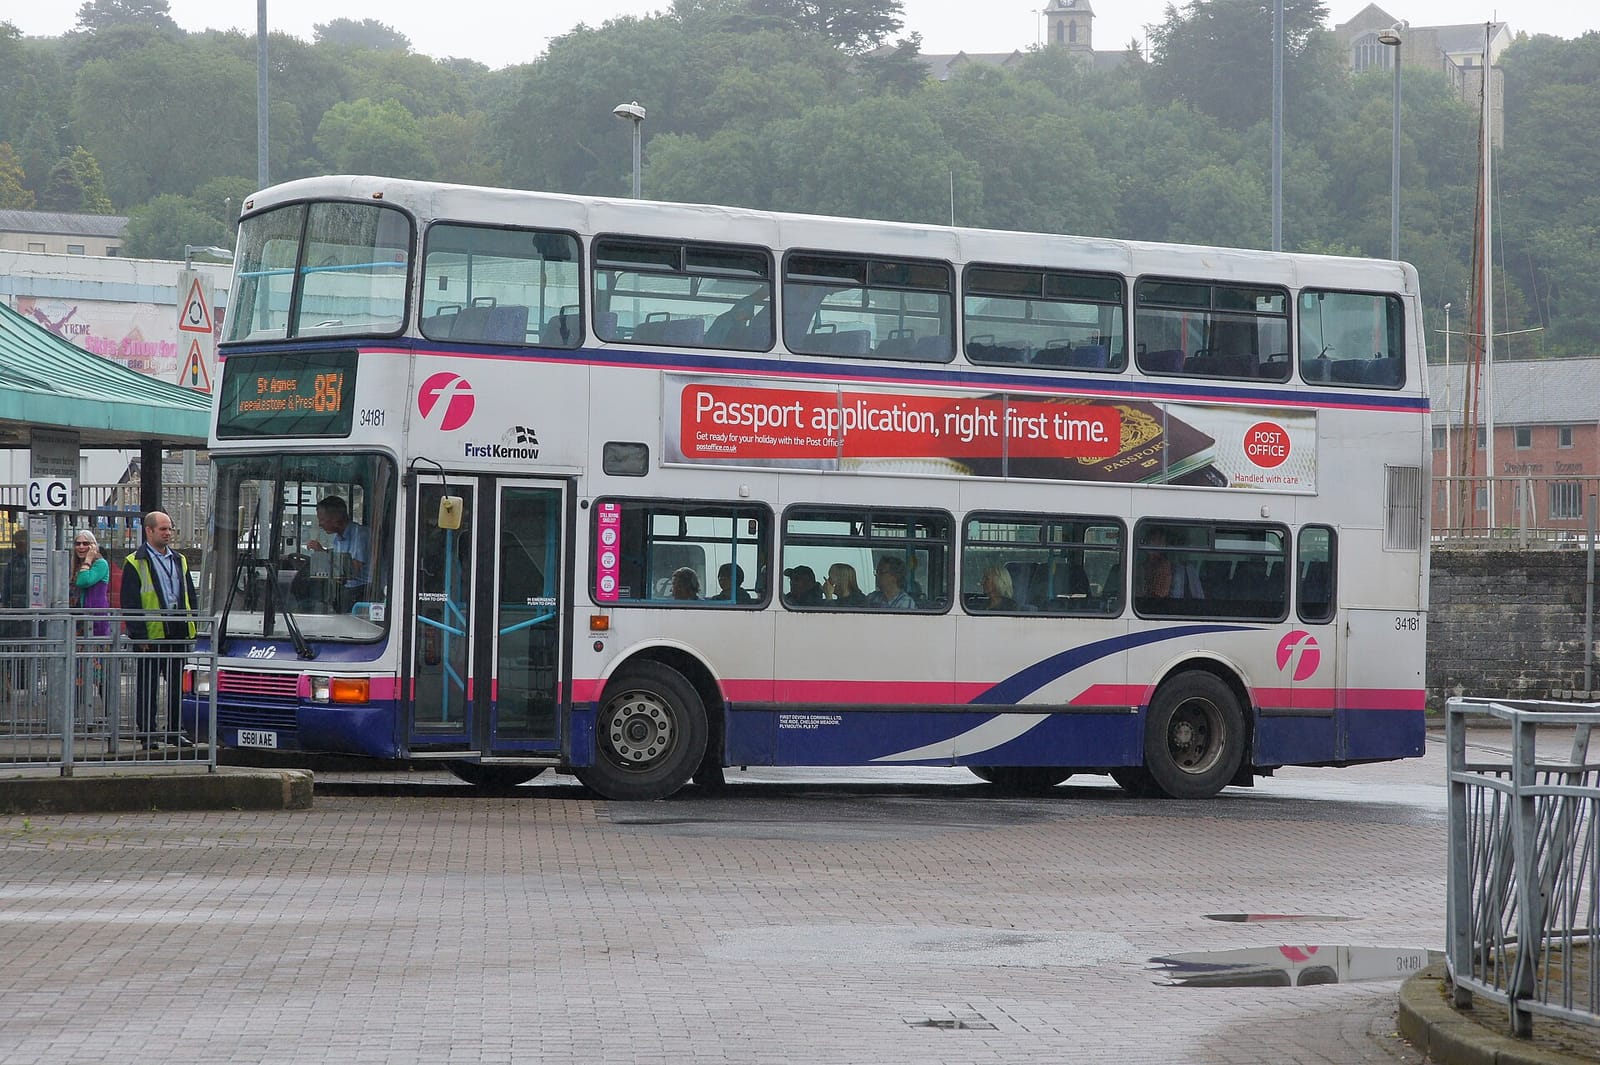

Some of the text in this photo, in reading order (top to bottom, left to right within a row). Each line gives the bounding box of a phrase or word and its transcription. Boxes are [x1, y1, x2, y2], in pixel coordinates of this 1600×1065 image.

[360, 409, 385, 426] 34181
[696, 391, 1109, 443] Passport application, right first time.
[696, 431, 708, 441] Get
[709, 432, 728, 443] ready
[728, 433, 739, 442] for
[738, 435, 754, 445] your
[755, 434, 778, 446] holiday
[778, 436, 793, 446] with
[793, 437, 804, 446] the
[806, 437, 821, 447] Post
[1254, 431, 1282, 444] POST
[696, 444, 737, 453] postoffice.co.uk
[1103, 439, 1170, 472] PASSPORT
[1248, 443, 1285, 457] OFFICE
[1234, 472, 1264, 483] Handled
[1265, 474, 1282, 484] with
[1283, 476, 1299, 485] care
[29, 482, 41, 507] G
[47, 482, 67, 507] G
[1395, 616, 1420, 631] 34181
[242, 731, 273, 747] S681 AAE
